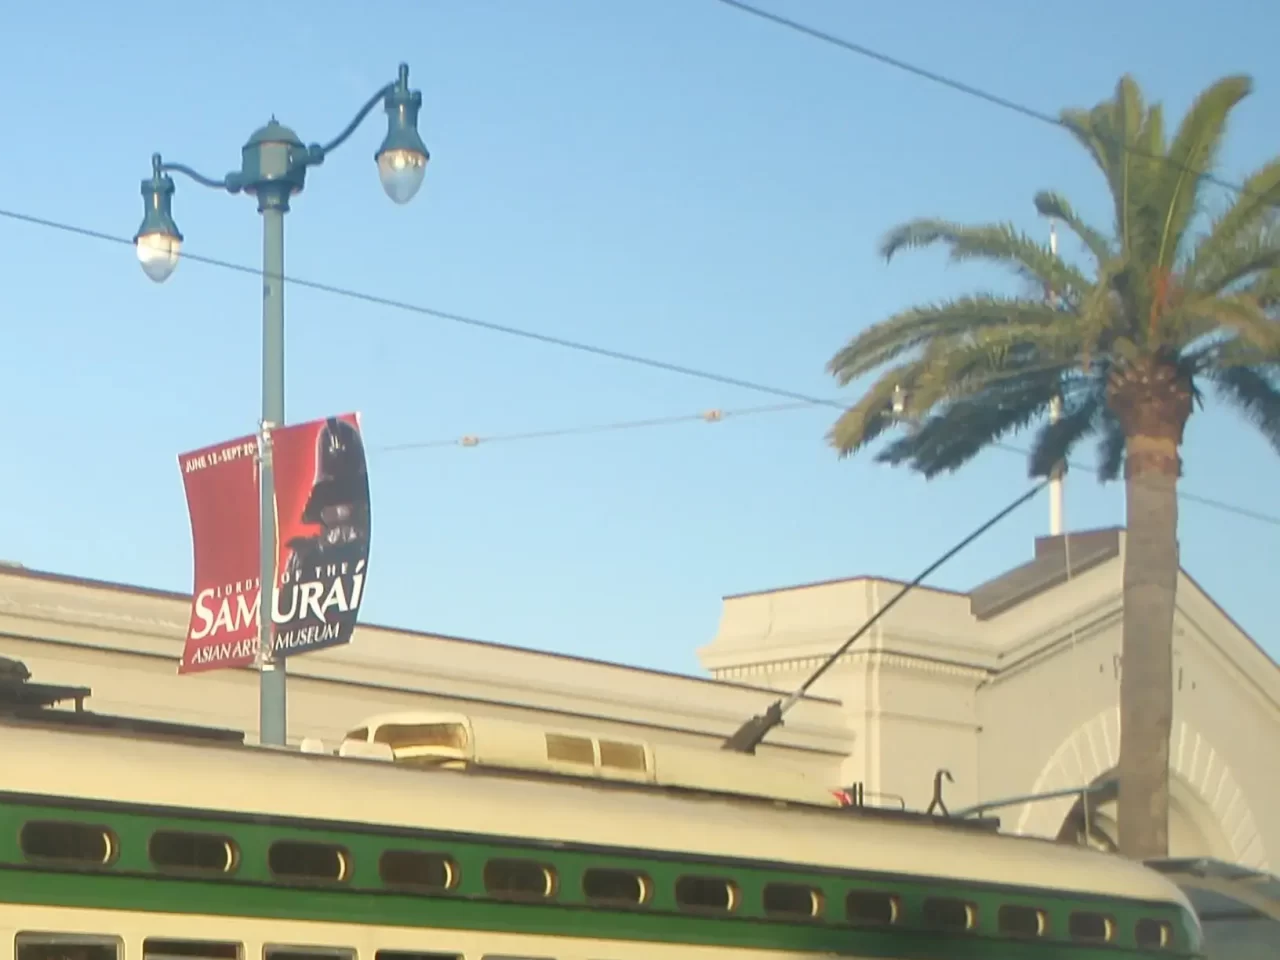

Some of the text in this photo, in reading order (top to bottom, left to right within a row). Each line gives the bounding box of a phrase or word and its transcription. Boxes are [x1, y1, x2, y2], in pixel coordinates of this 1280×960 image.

[186, 455, 207, 473] JUNE
[280, 569, 302, 584] OF
[315, 561, 348, 579] THE
[191, 621, 340, 665] ASIAN ART MUSEUM
